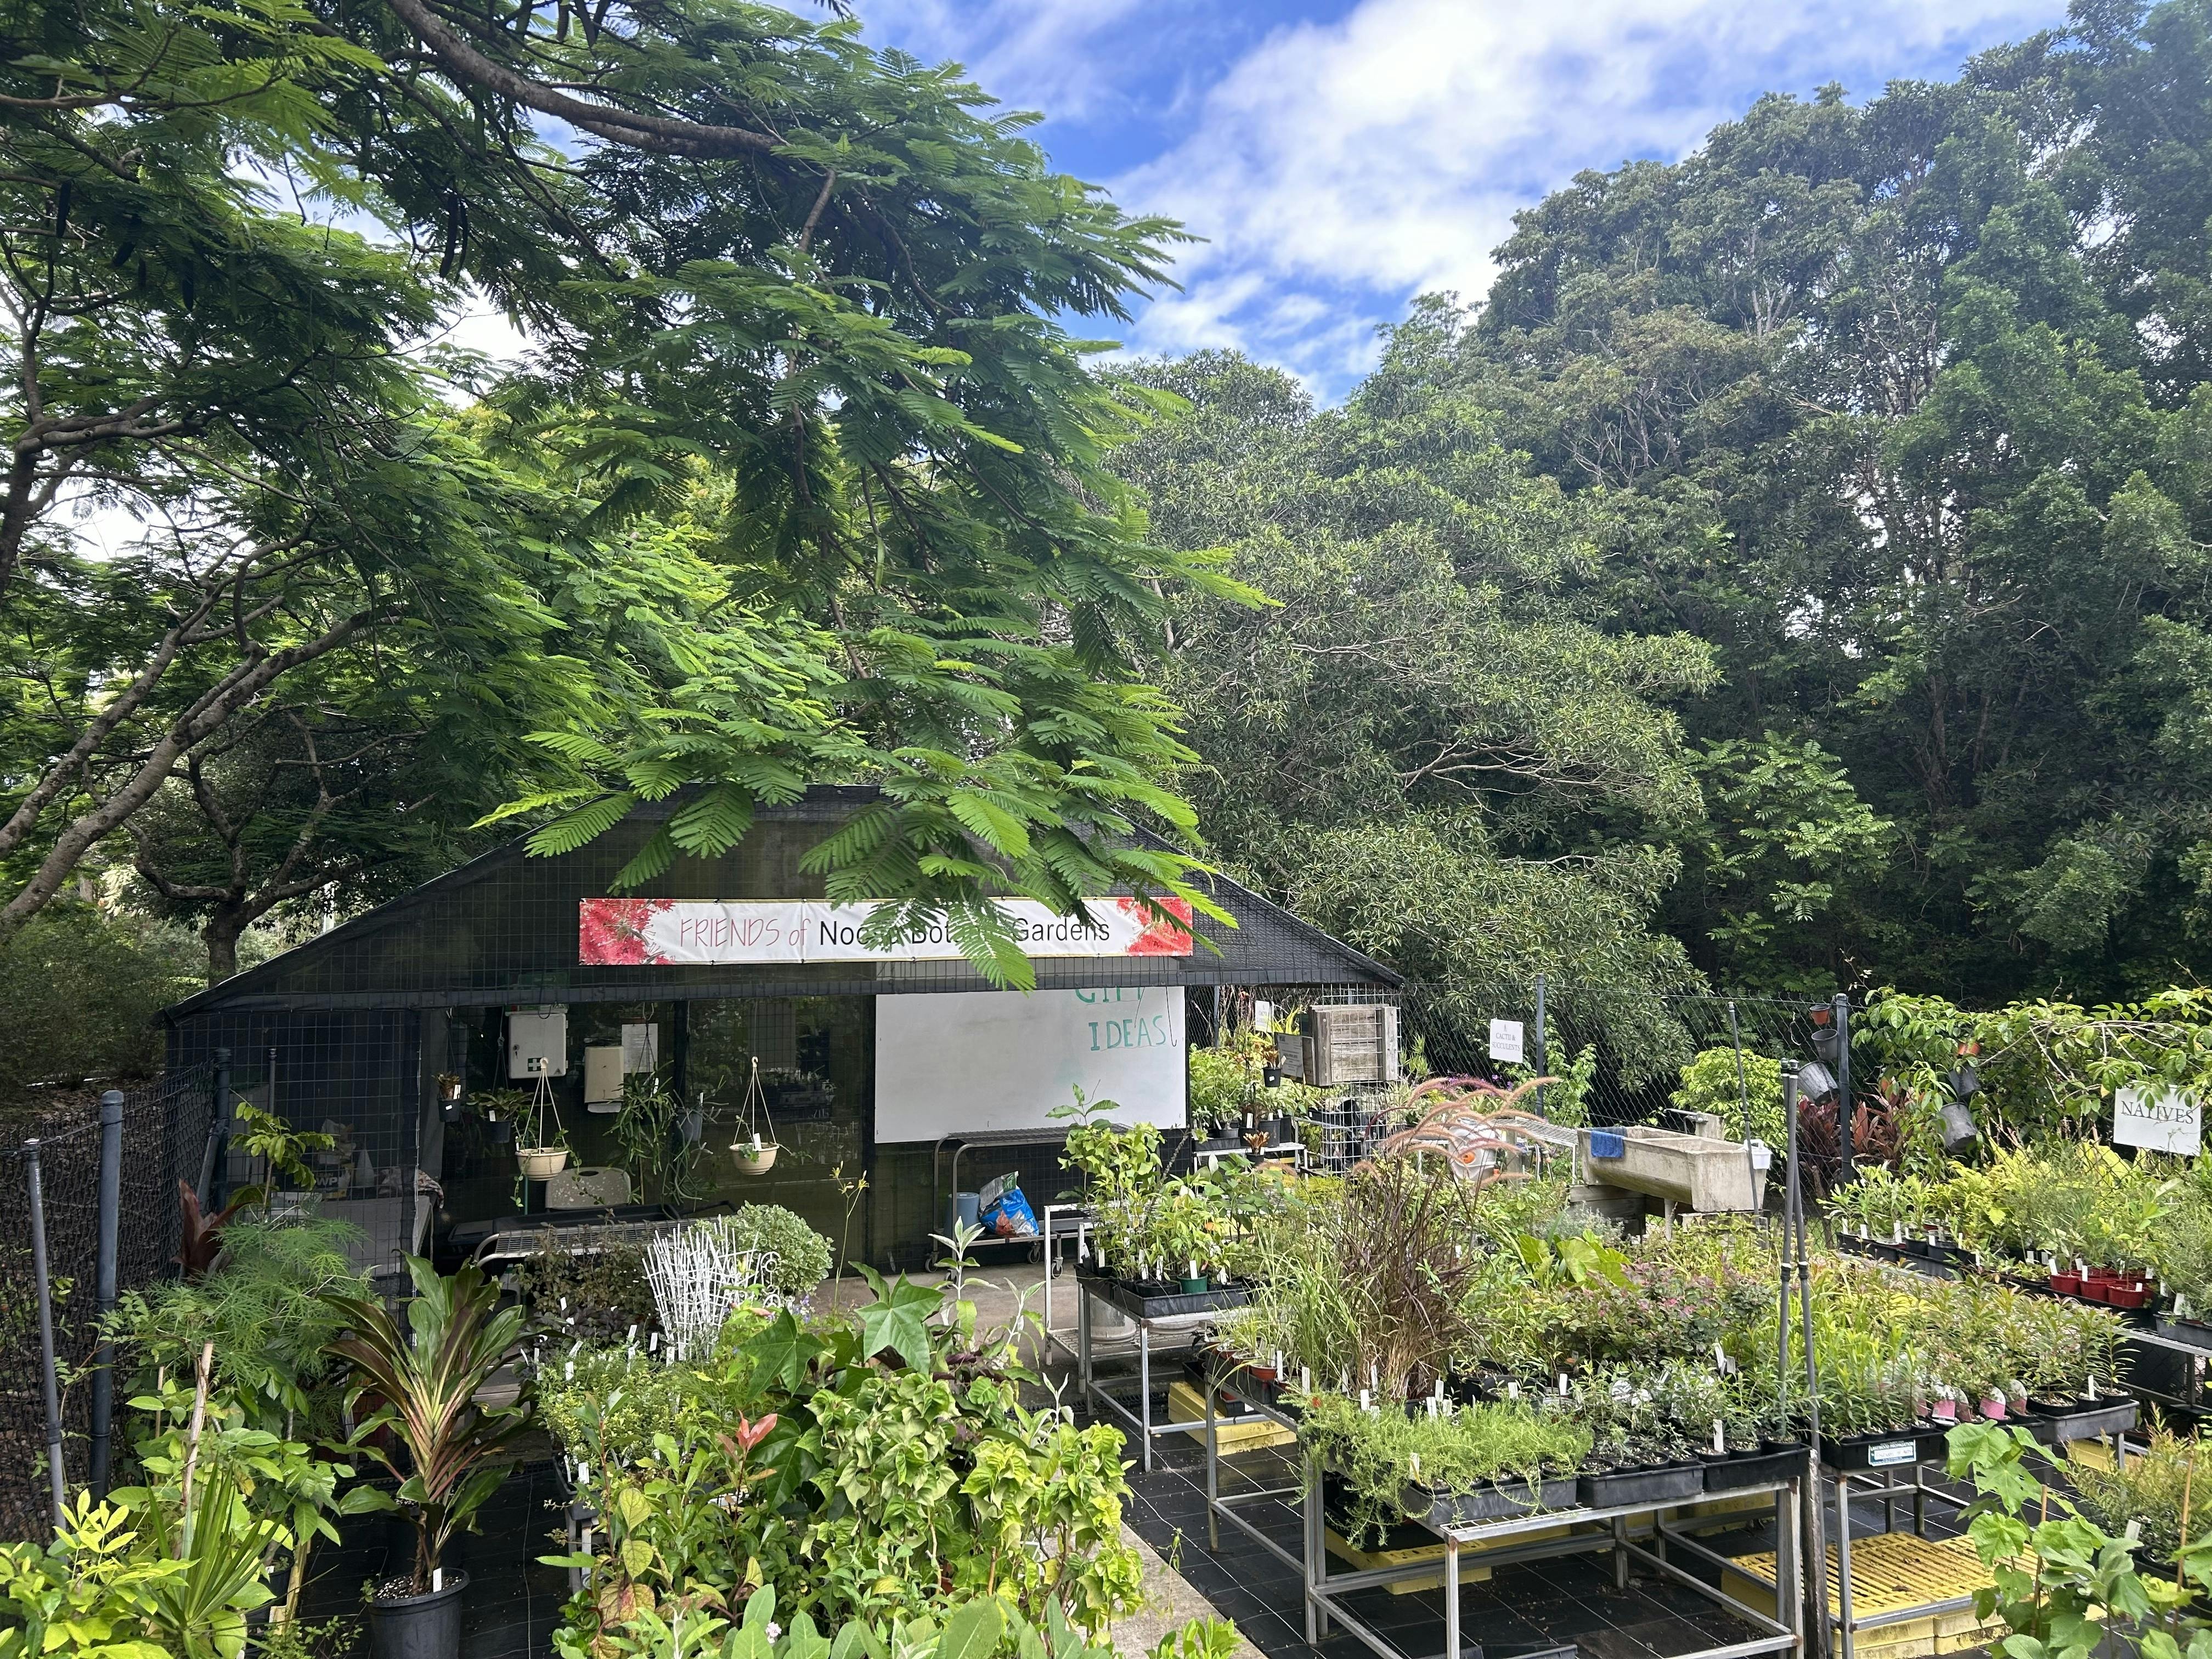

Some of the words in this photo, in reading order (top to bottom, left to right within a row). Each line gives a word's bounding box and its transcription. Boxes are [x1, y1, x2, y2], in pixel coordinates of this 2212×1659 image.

[680, 918, 780, 947] FRIENDS
[788, 918, 811, 947] of
[1013, 917, 1110, 942] Gardens
[1088, 1015, 1166, 1051] IDEAS
[1491, 1041, 1520, 1051] SUCCULENTS
